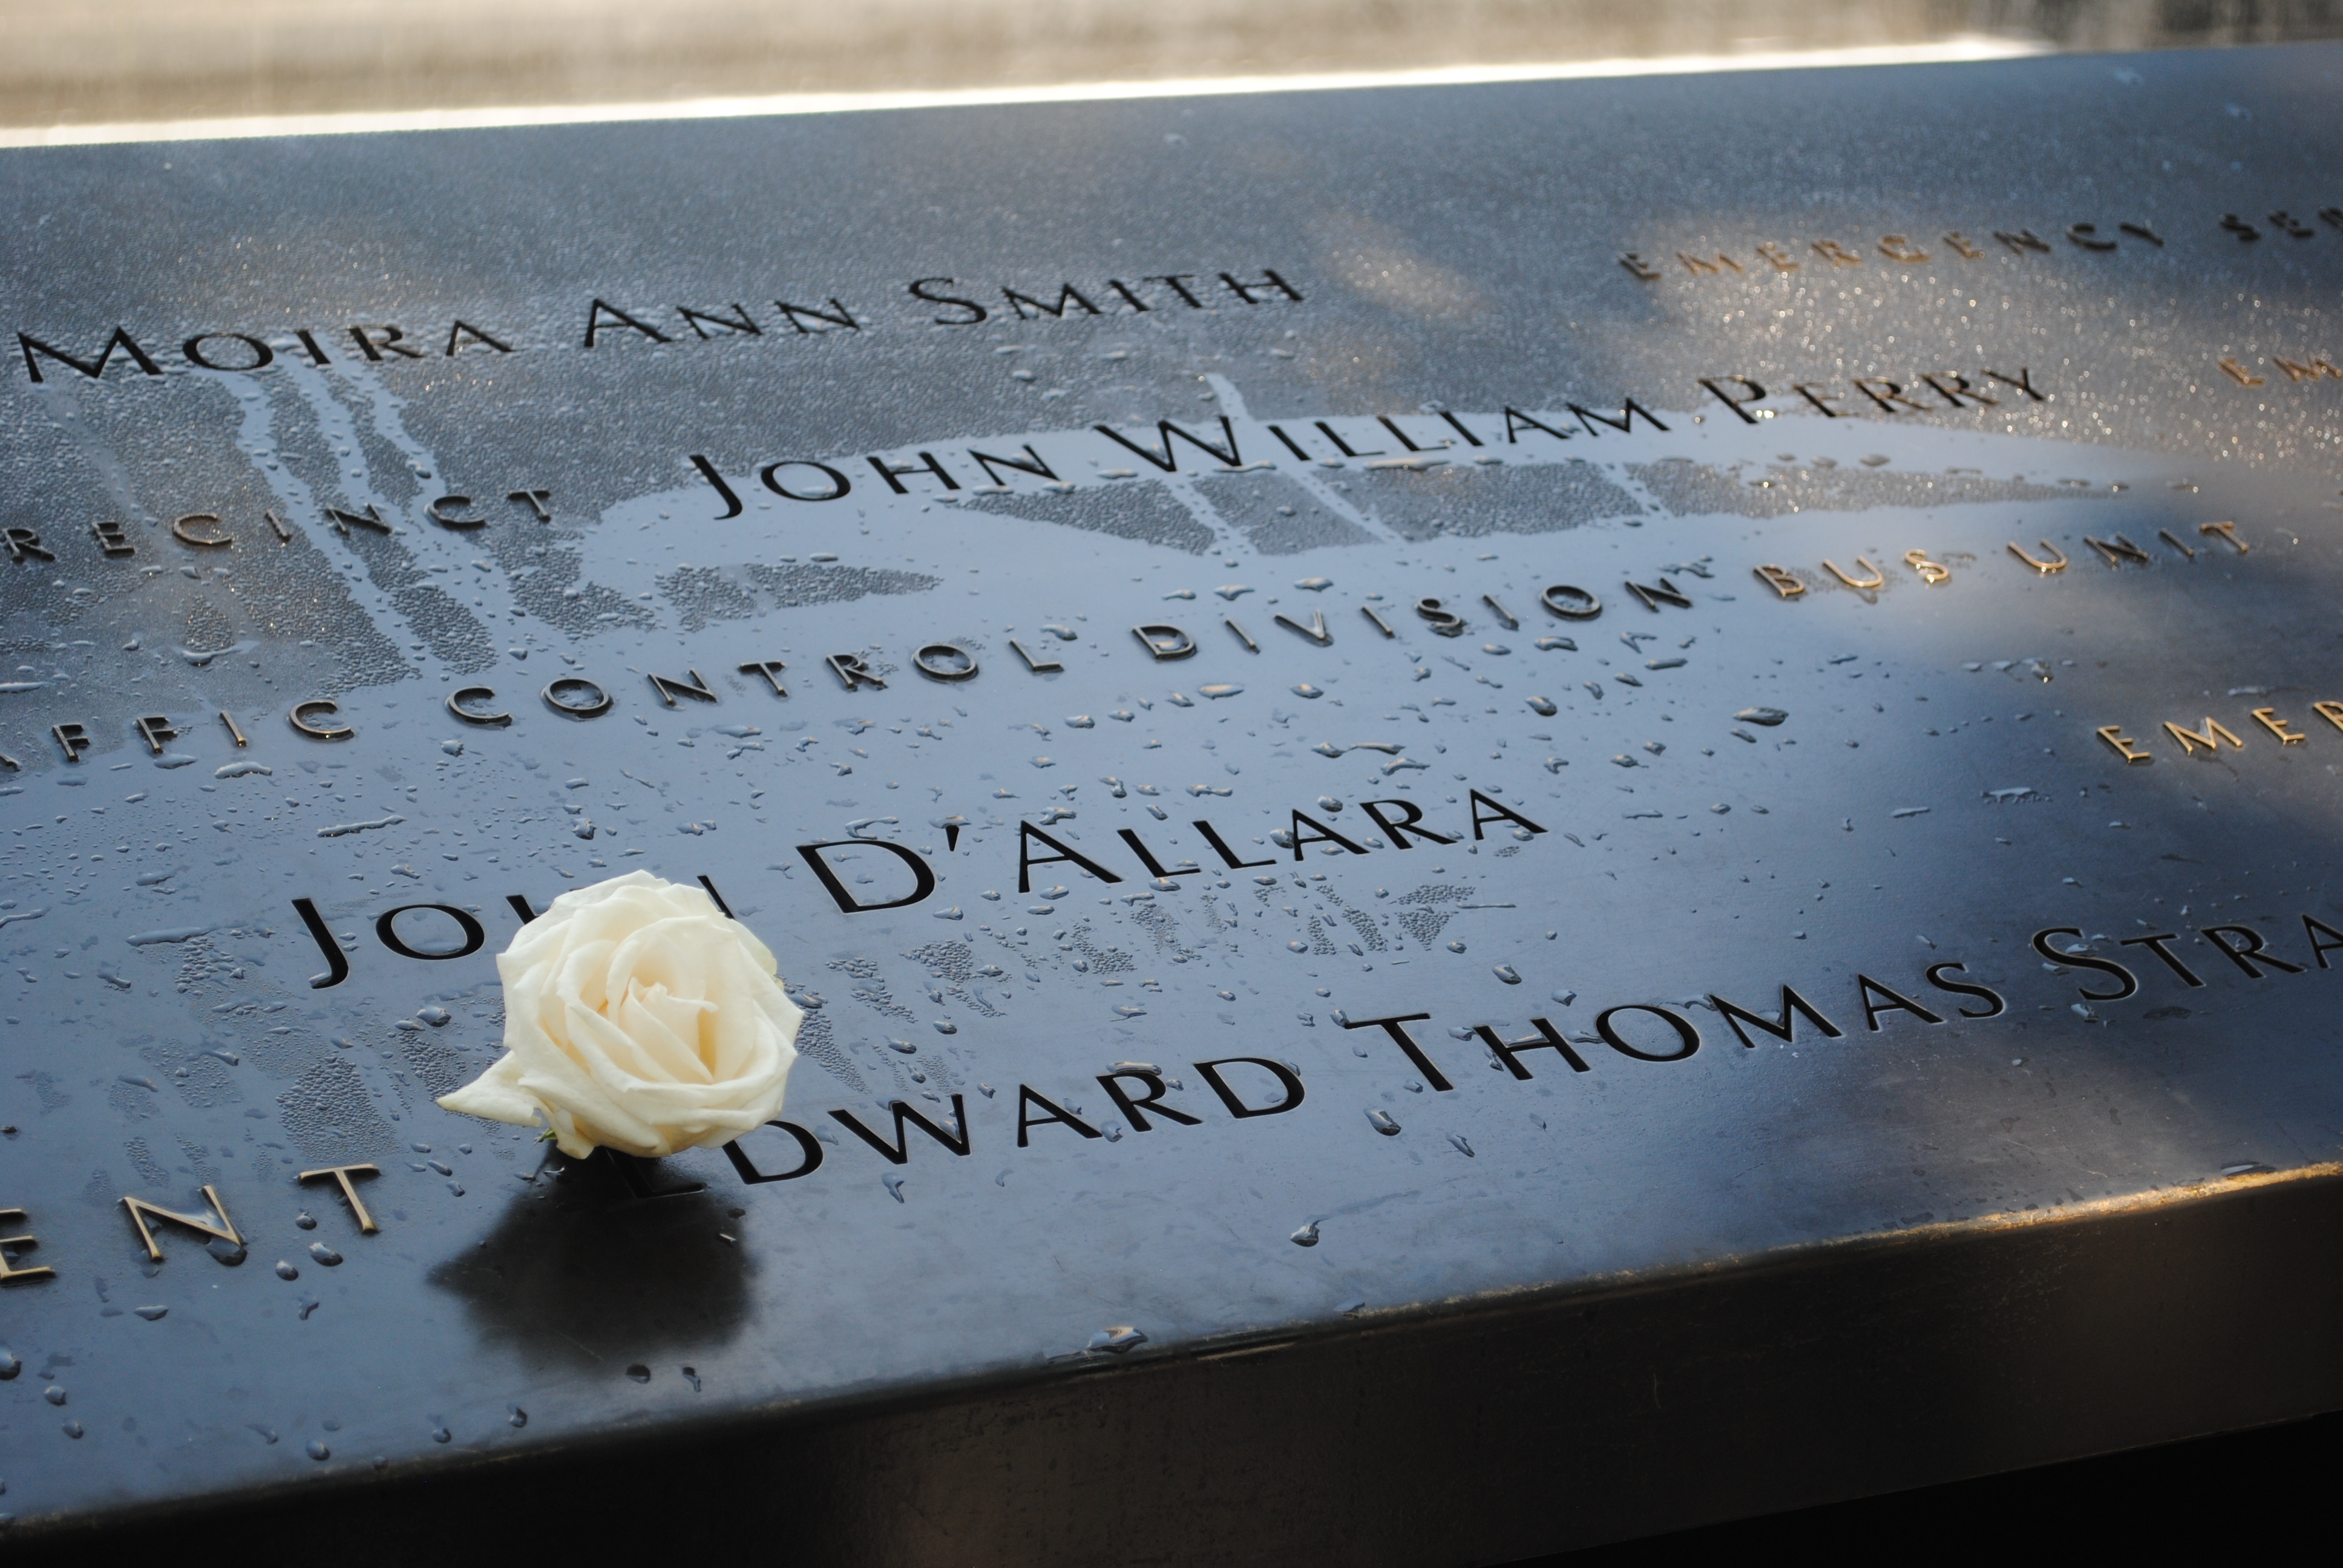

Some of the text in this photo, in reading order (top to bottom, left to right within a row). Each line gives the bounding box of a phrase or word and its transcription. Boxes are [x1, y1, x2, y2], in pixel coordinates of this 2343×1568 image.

[18, 269, 1304, 382] MOIRA ANN SMITH
[689, 367, 2046, 520] JOHN WILLIAM PERRY
[1, 490, 552, 564] RECINCT
[0, 521, 2249, 772] FFIC CONTROL DIVISION BUS UNIT
[291, 789, 1548, 990] JO D'ALLARA
[1344, 962, 2006, 1092] THOMAS
[2031, 913, 2343, 1002] STRA
